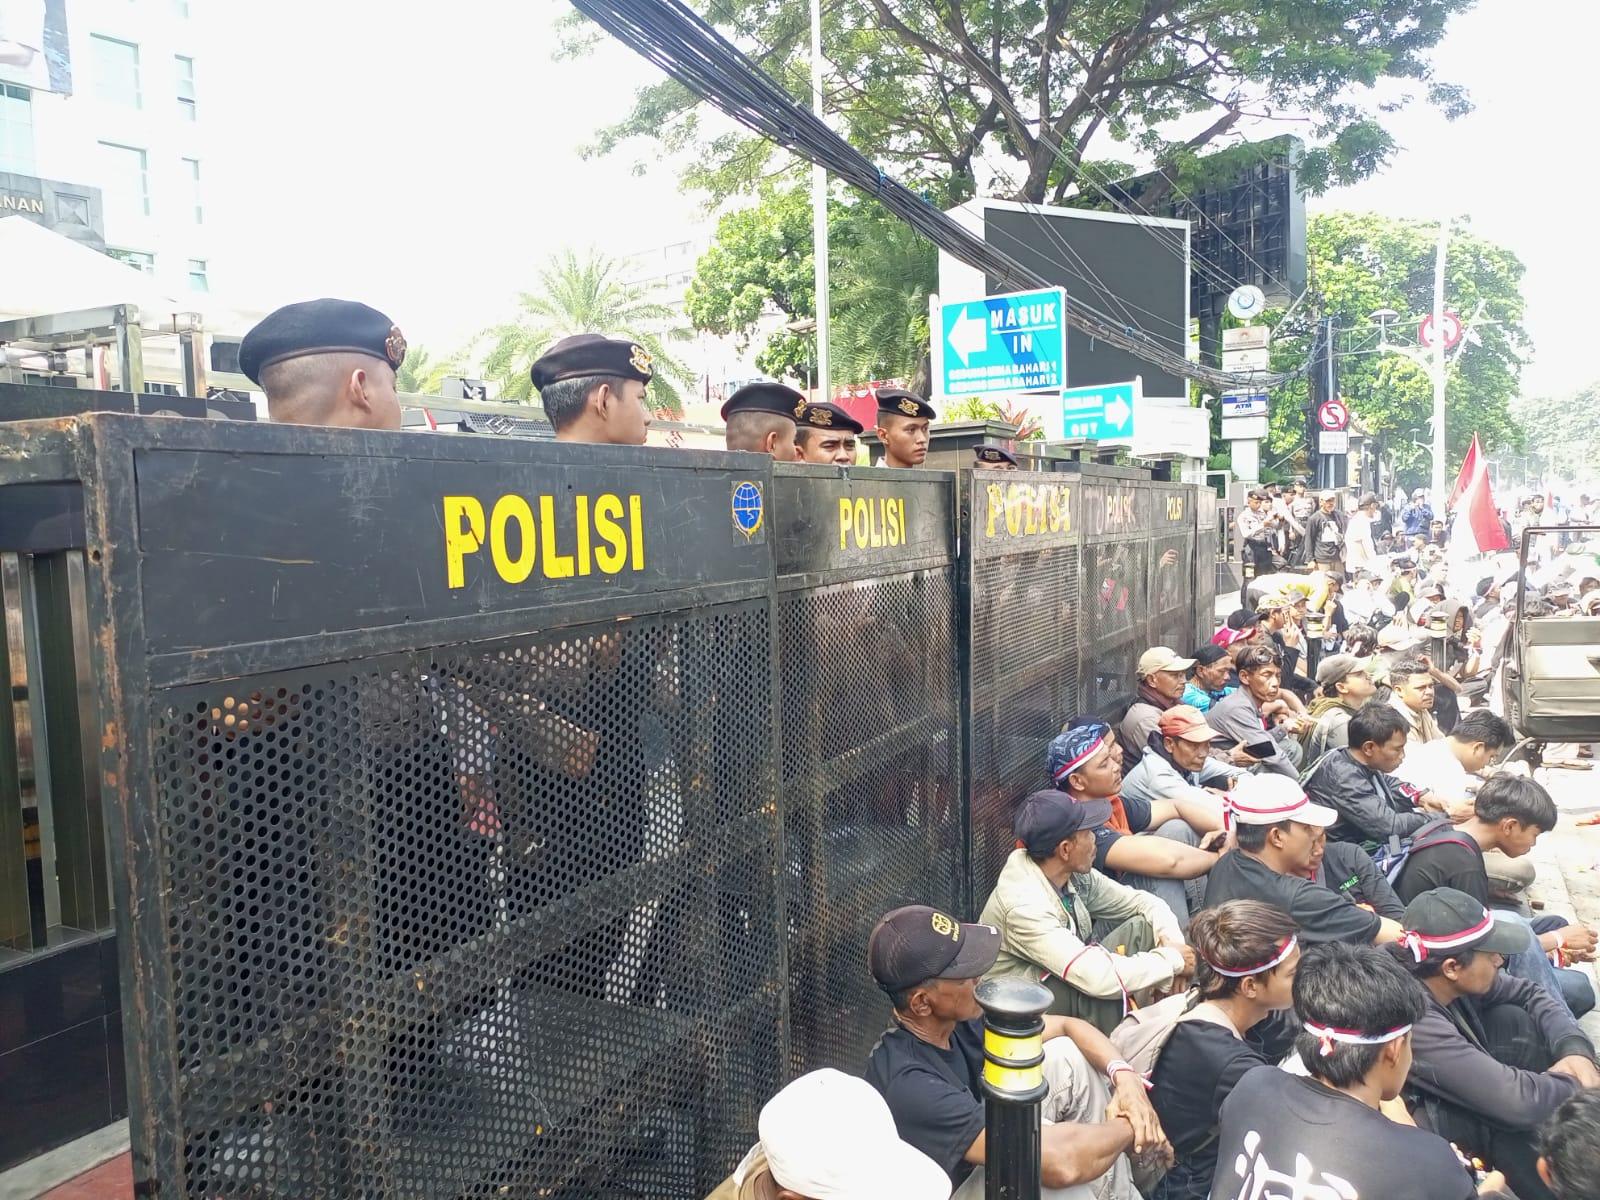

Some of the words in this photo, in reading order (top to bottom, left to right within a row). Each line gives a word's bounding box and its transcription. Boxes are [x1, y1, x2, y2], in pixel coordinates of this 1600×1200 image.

[0, 195, 44, 214] NAN
[990, 302, 1057, 329] MASUK
[1013, 333, 1033, 354] IN
[1071, 421, 1098, 437] OUT
[839, 498, 907, 551] POLISI
[444, 493, 645, 589] POLISI
